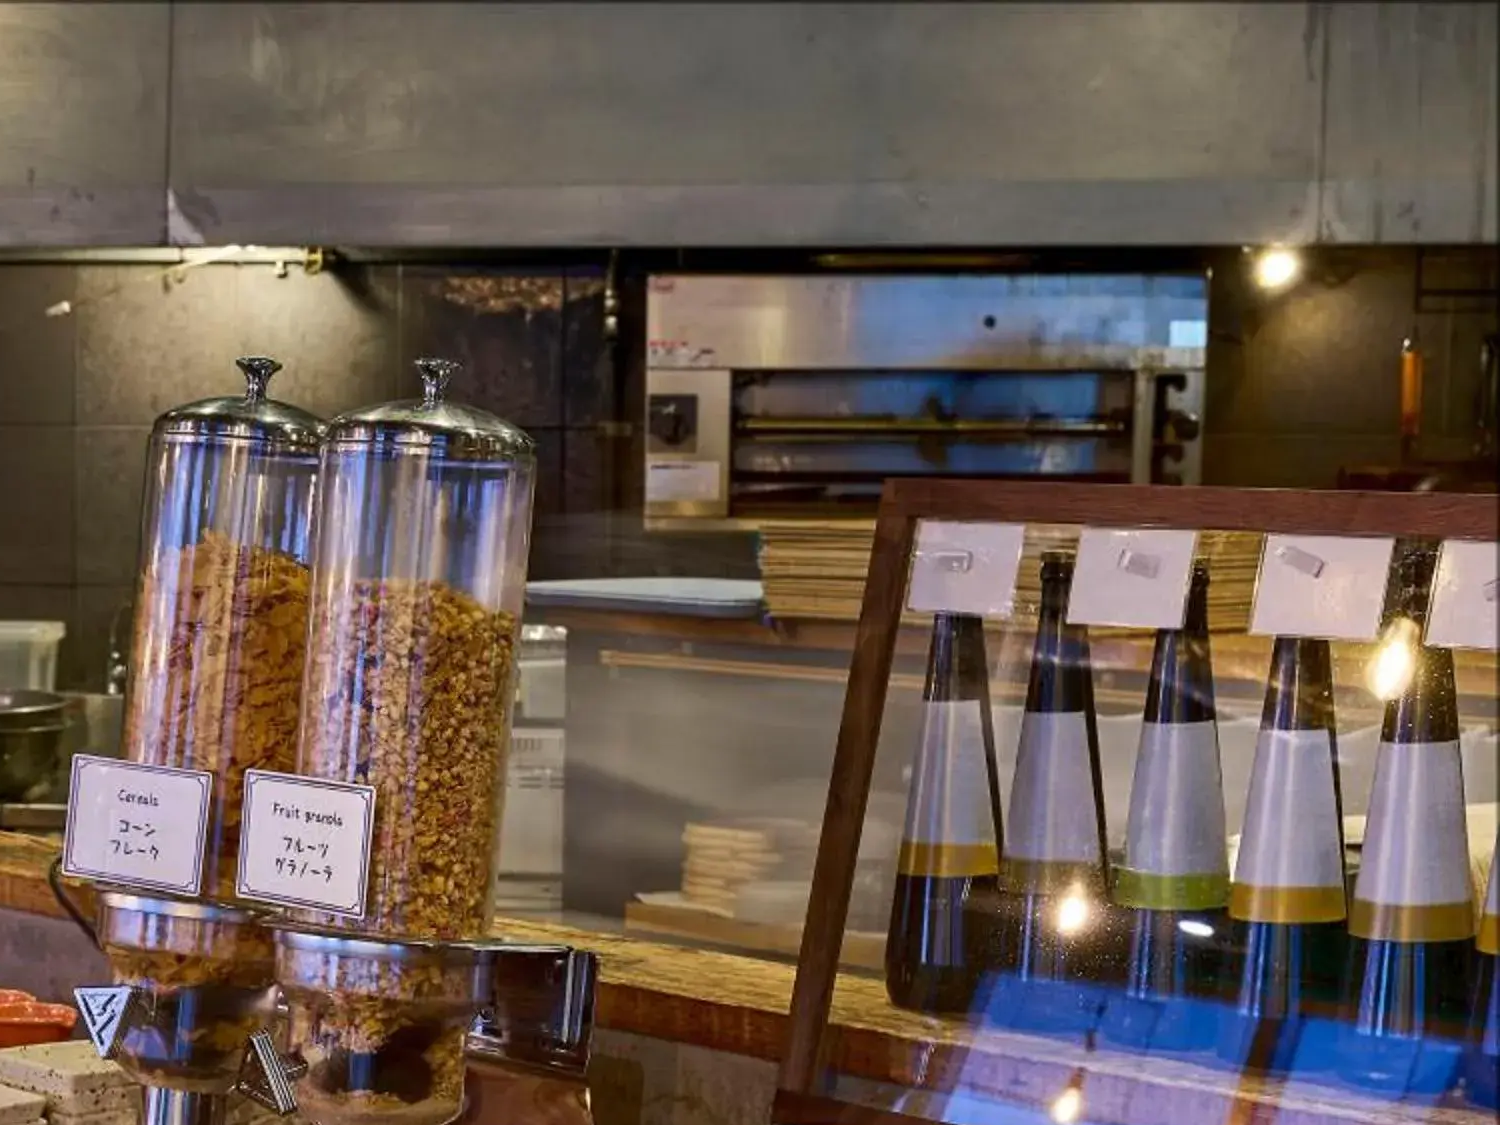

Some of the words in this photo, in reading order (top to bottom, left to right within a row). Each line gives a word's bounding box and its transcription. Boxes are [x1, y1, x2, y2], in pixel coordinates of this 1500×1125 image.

[117, 789, 159, 807] Cereals
[272, 802, 301, 821] Fruit
[304, 810, 343, 827] granola
[119, 819, 156, 837] コーン
[109, 840, 159, 860] フレーク
[282, 836, 329, 857] フルーツ
[275, 858, 333, 883] グラノーラ
